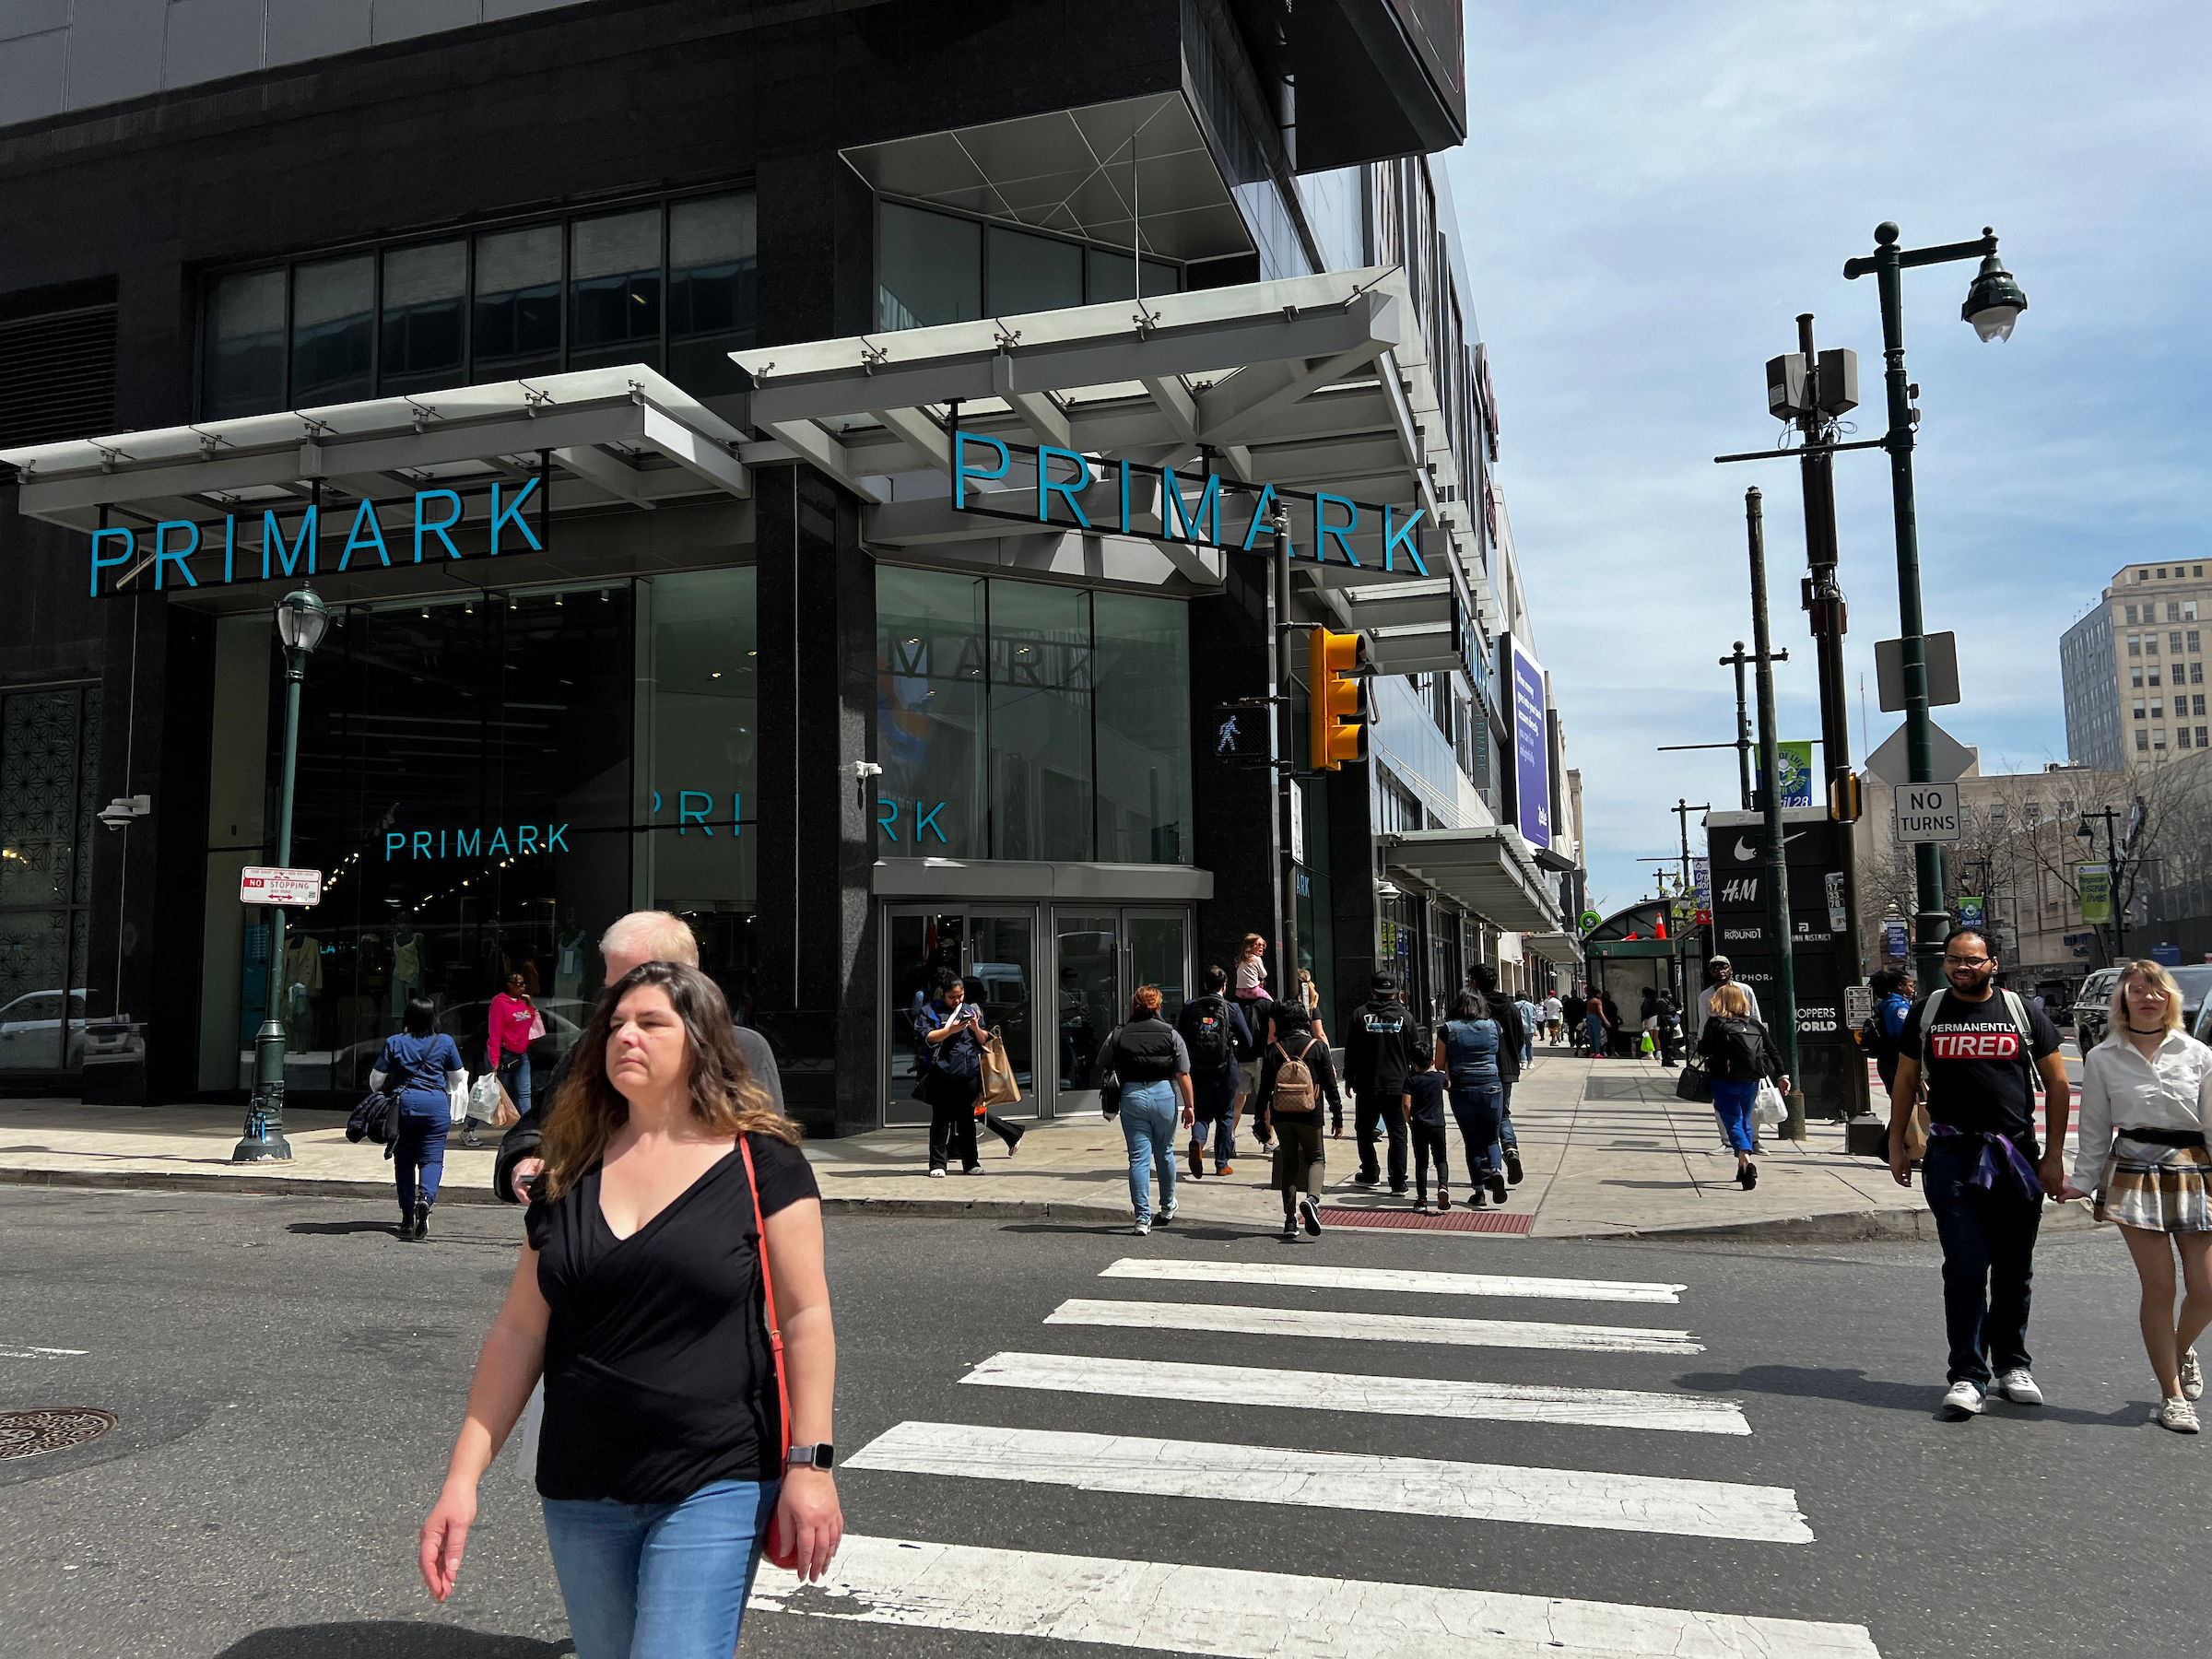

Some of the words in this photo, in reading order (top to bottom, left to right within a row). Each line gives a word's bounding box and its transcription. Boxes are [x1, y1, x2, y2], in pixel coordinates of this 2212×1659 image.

[956, 430, 1430, 576] PRIMARK
[90, 477, 543, 597] PRIMARK
[1476, 712, 1486, 771] PRIMARK
[1790, 754, 1806, 766] LIFE
[1793, 795, 1809, 808] 28
[1911, 792, 1942, 810] NO
[1900, 816, 1955, 831] TURNS
[386, 823, 569, 861] PRIMARK
[250, 878, 262, 887] NO
[270, 881, 310, 890] STOPPING
[1722, 878, 1758, 902] H&M
[1829, 891, 1840, 900] 33
[2087, 893, 2107, 903] lives
[1830, 900, 1841, 908] 78
[1931, 1022, 2016, 1033] PERMANENTLY
[1935, 1036, 2016, 1056] TIRED
